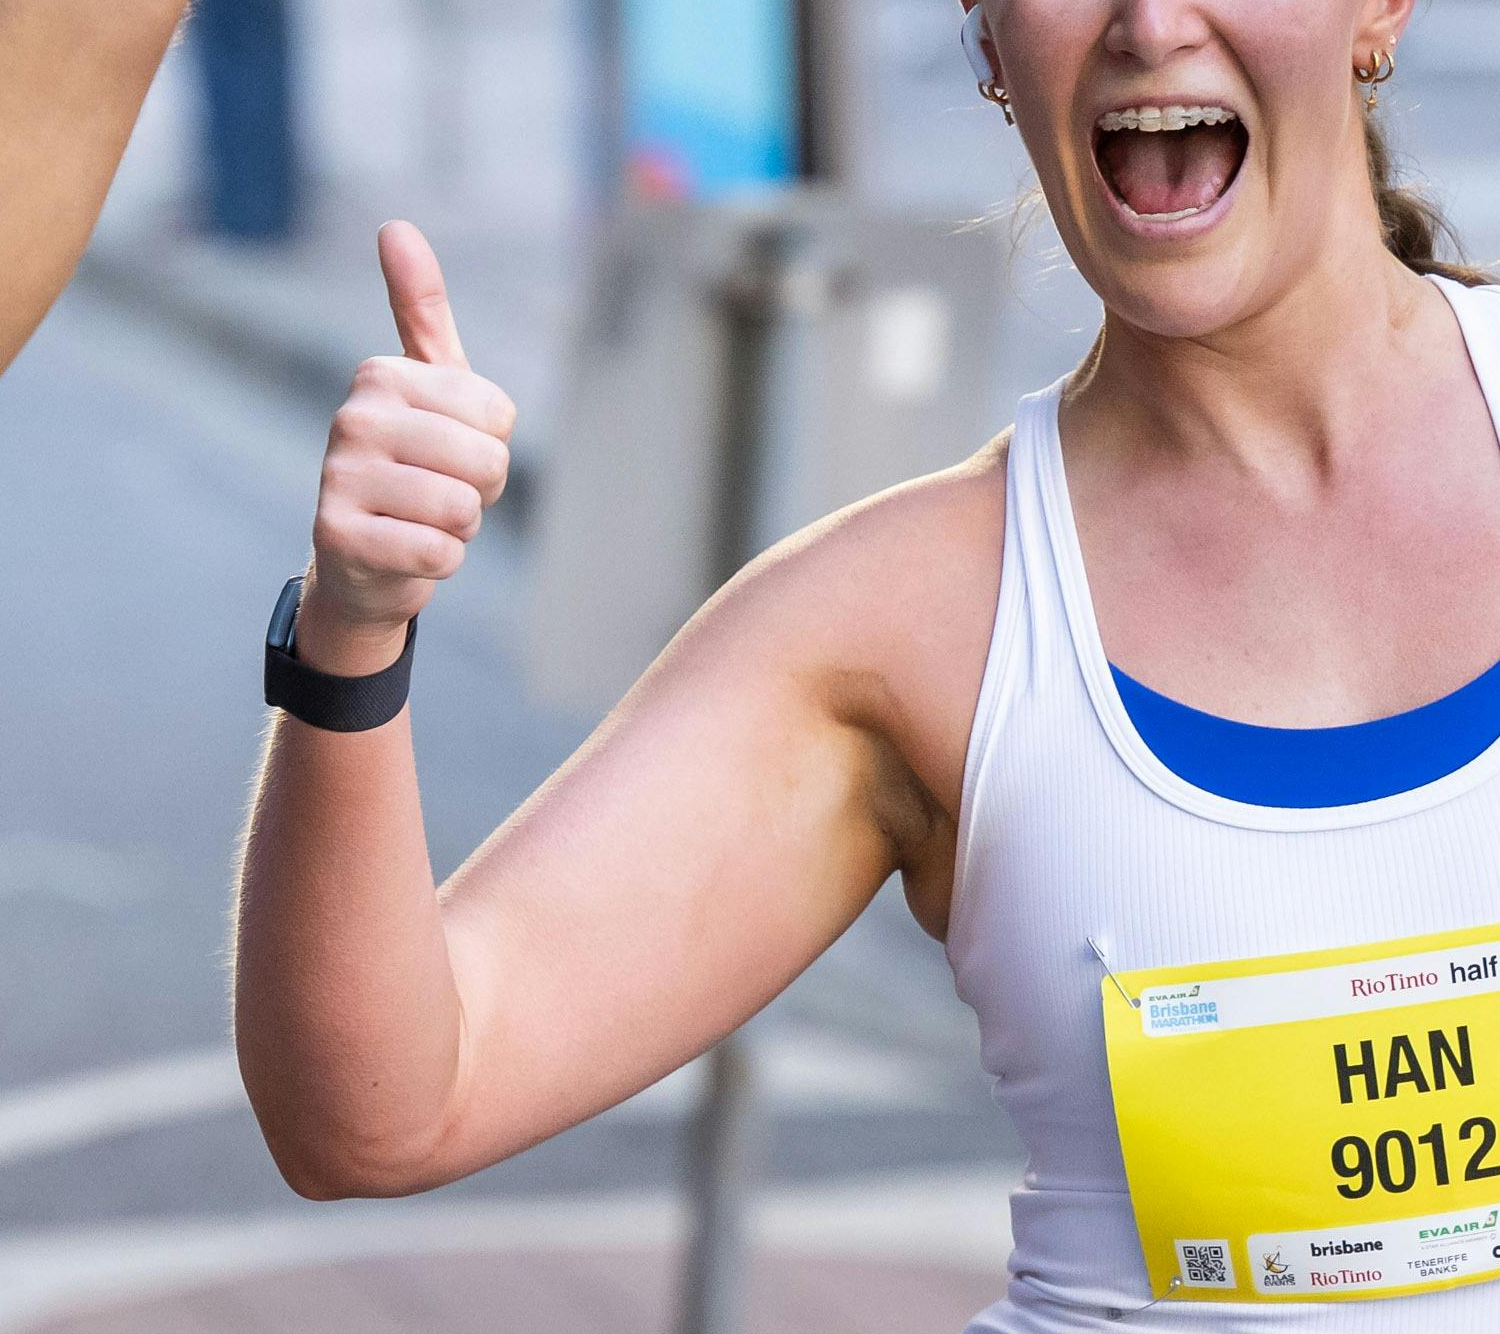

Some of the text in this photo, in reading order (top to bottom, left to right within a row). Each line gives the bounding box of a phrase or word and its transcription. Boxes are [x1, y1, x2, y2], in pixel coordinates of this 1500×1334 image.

[1450, 955, 1497, 983] half
[1149, 1001, 1217, 1018] Brisbane
[1151, 1013, 1218, 1028] MARATHON
[1333, 1025, 1475, 1104] HAN
[1310, 1240, 1383, 1257] brisbane
[1408, 1253, 1468, 1270] TENERIFFE
[1420, 1265, 1458, 1277] BANKS
